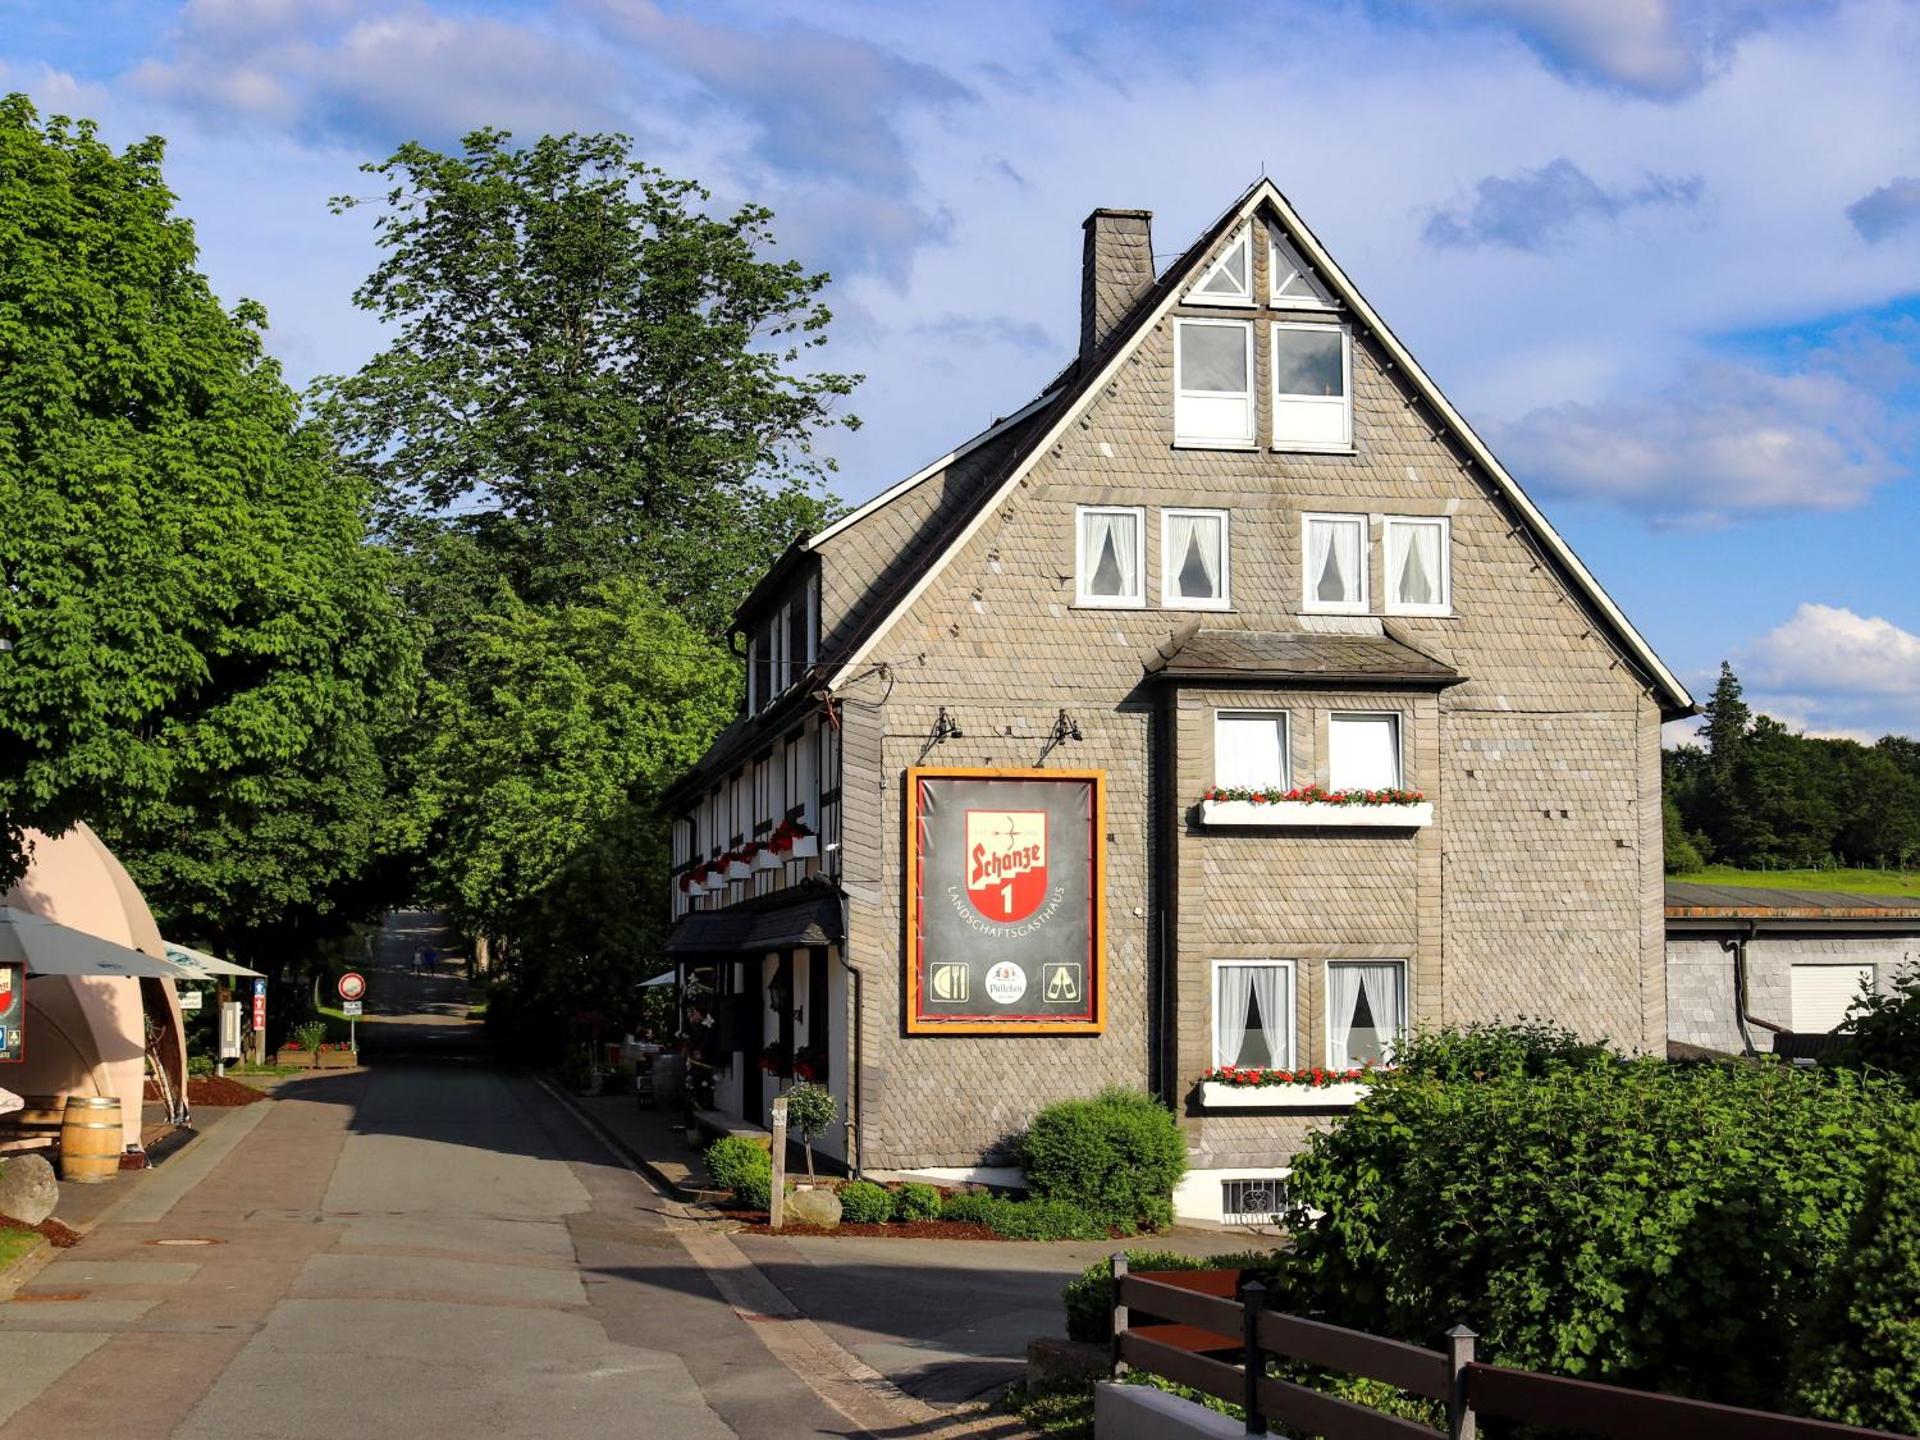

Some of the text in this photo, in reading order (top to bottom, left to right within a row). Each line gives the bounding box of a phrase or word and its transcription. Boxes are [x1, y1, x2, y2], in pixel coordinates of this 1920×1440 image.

[972, 843, 1040, 884] Schanze
[948, 886, 1065, 938] LANDSCHAFTSGASTHAUS
[1000, 884, 1012, 913] 1
